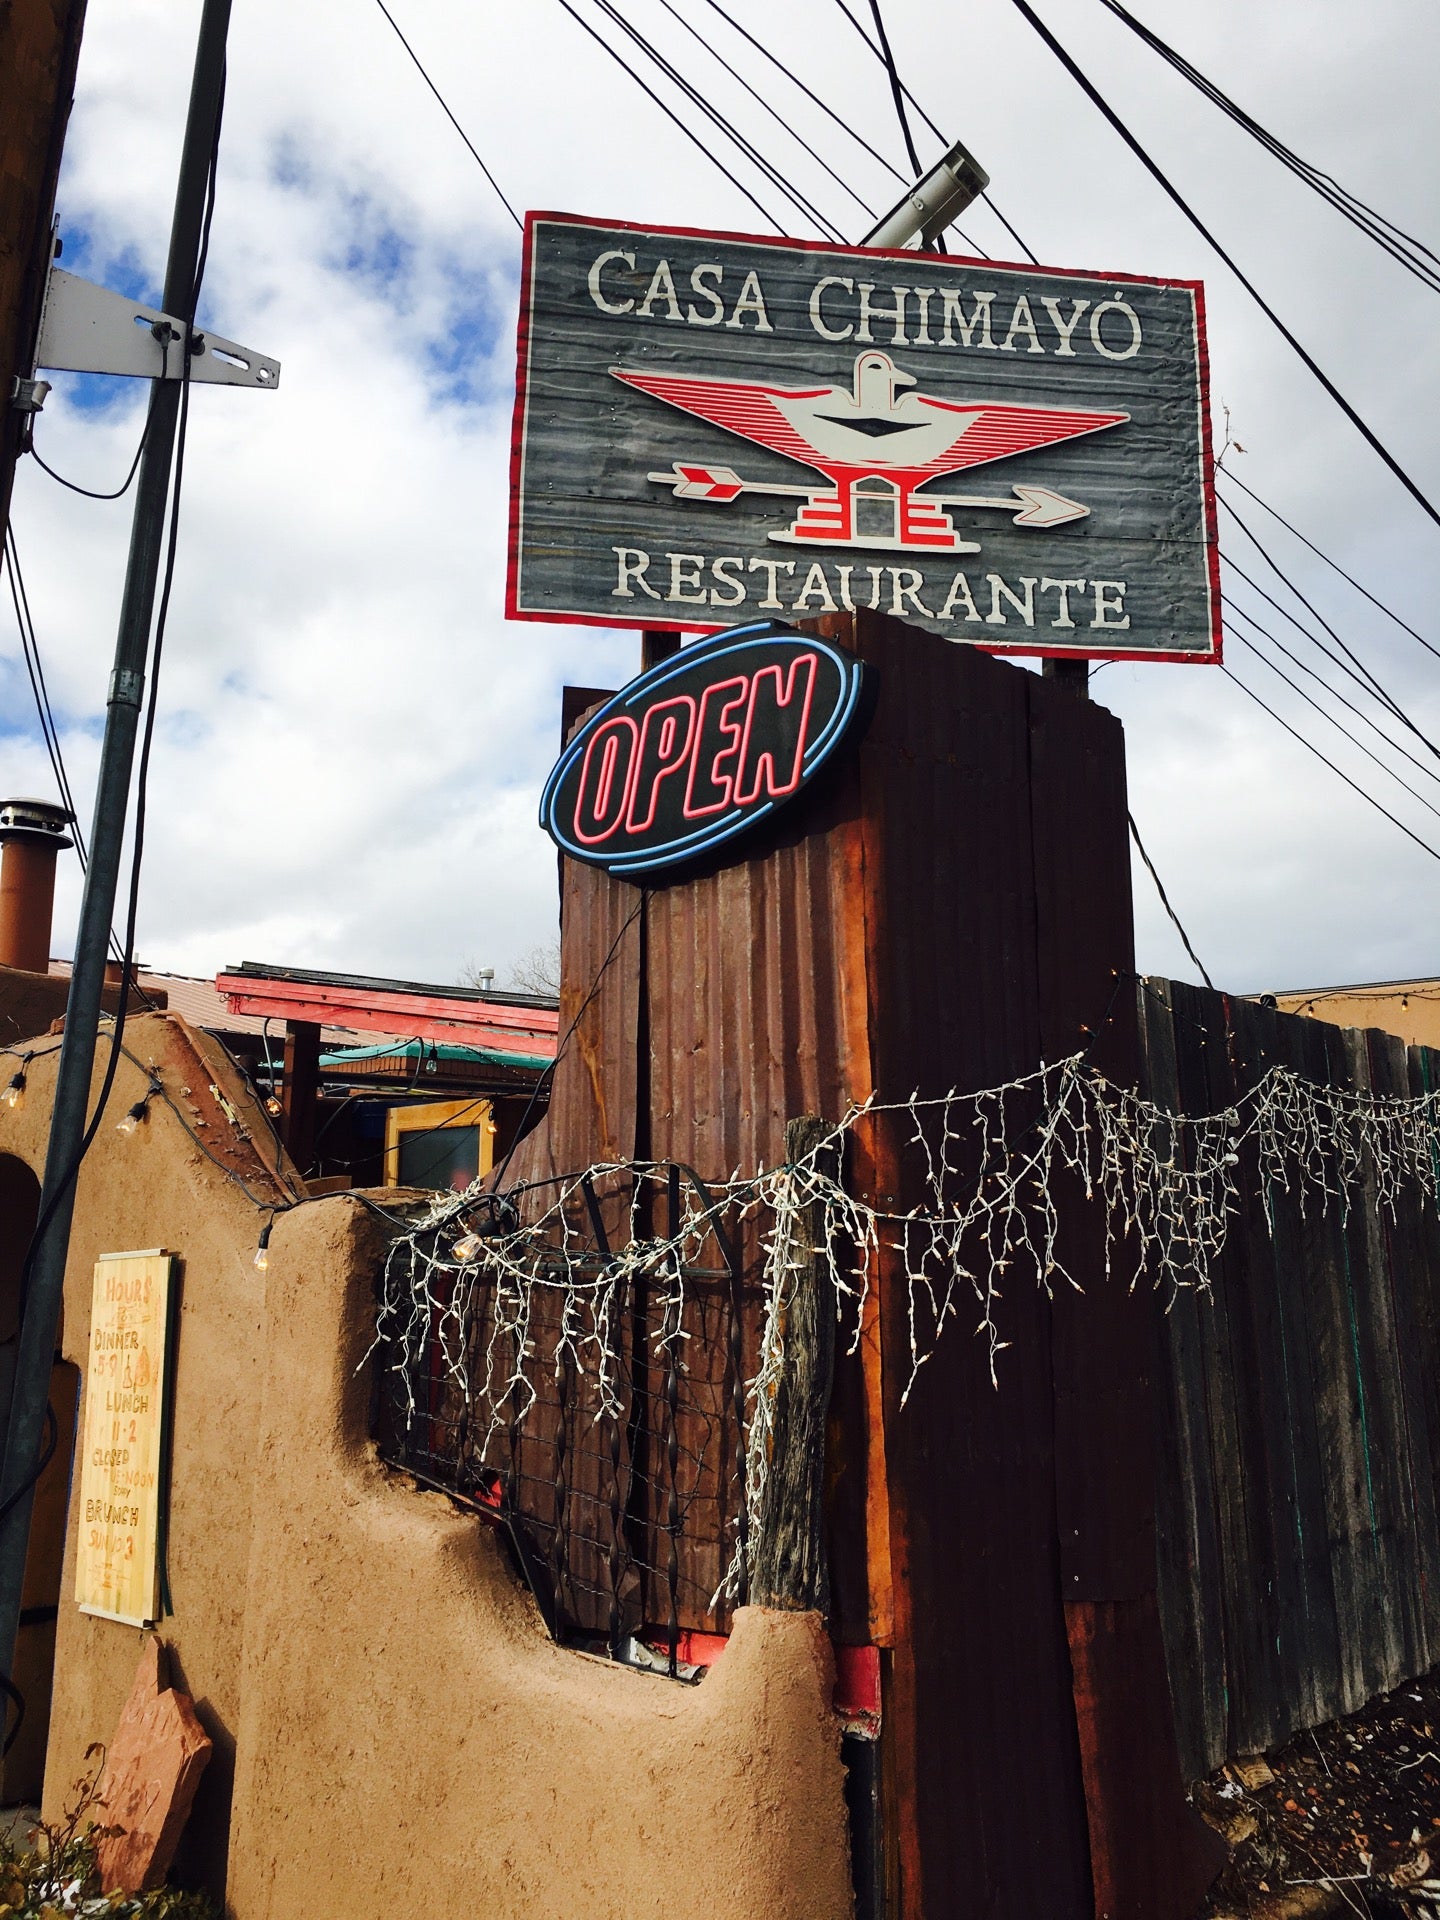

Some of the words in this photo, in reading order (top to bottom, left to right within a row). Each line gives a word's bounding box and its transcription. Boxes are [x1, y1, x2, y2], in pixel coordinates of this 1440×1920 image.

[588, 250, 774, 332] CASA
[809, 276, 1143, 360] CHIMAYÓ
[611, 546, 1130, 629] RESTAURANTE
[573, 653, 818, 845] OPEN
[106, 1275, 152, 1304] HOURS
[94, 1328, 139, 1350] DINNER
[106, 1390, 149, 1414] LUNCH
[92, 1448, 129, 1467] CLOSED
[86, 1499, 139, 1526] BRUNCH
